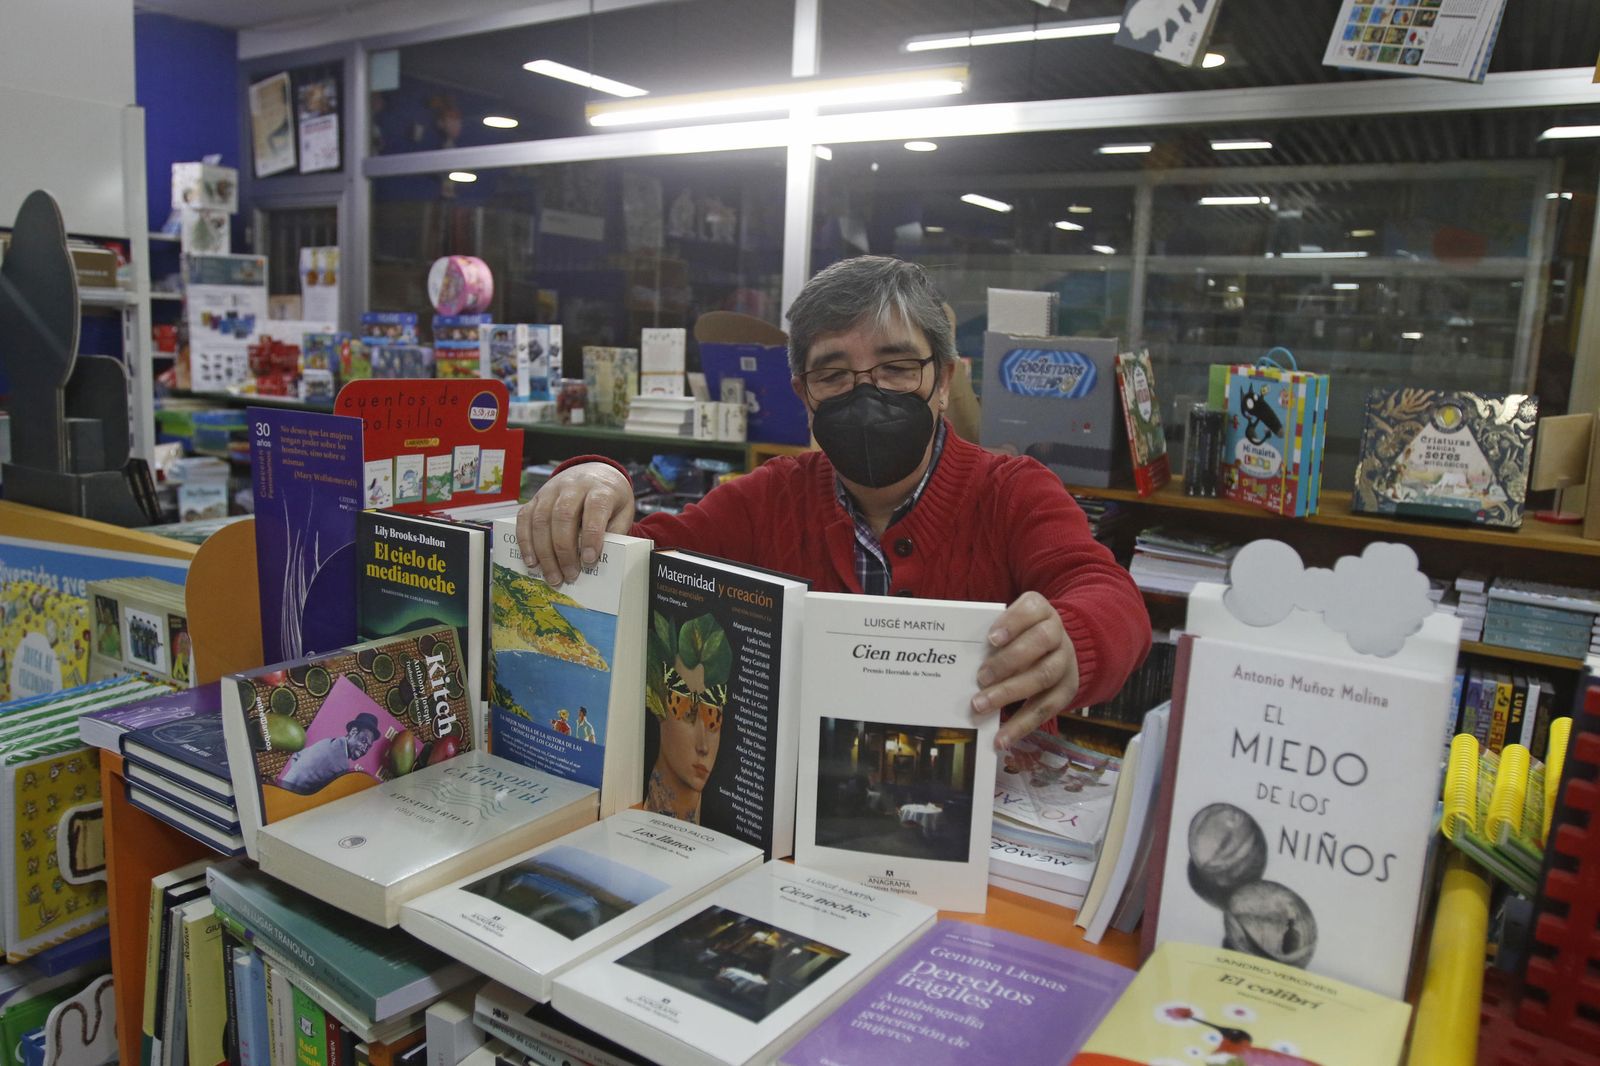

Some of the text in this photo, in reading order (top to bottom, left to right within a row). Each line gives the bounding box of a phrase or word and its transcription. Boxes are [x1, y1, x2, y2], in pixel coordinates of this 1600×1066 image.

[345, 385, 459, 408] cuentos de
[361, 408, 443, 431] bolsillo
[256, 422, 270, 437] 30
[291, 427, 307, 435] deseo
[309, 429, 319, 438] que
[321, 429, 329, 437] las
[330, 432, 353, 441] mujeres
[280, 437, 346, 450] tengan poder sobre los
[1421, 436, 1470, 447] Criaturas
[324, 451, 339, 460] sobre
[1243, 444, 1276, 459] Mi maleta
[1425, 451, 1461, 461] seres
[282, 459, 304, 467] mismas
[294, 471, 312, 480] (Mary
[375, 525, 445, 548] Lily Brooks-Dalton
[375, 542, 446, 573] El cielo de
[367, 564, 456, 595] medianoche
[658, 564, 773, 609] Maternidad y creación
[733, 622, 772, 638] Margaret Atwood
[864, 617, 945, 631] LUISGÉ MARTÍN
[747, 637, 771, 649] Lydia Davis
[740, 655, 752, 665] Mary
[742, 646, 770, 660] Annie Ernaux
[853, 644, 956, 665] Cien noches
[742, 666, 770, 680] Susan Griffin
[739, 675, 769, 690] Nancy Huston
[1234, 664, 1389, 708] Antonio Muñoz Molina
[413, 660, 432, 725] Anthony Joseph
[426, 652, 457, 737] Kitch
[753, 691, 768, 700] Lazarre
[732, 693, 746, 703] Ursula
[757, 703, 768, 711] Guin
[1511, 692, 1525, 724] LUNA
[735, 714, 767, 730] Margaret Mead
[740, 706, 767, 723] Doris Lessing
[1264, 704, 1285, 726] EL
[519, 722, 533, 732] NOVELA
[540, 730, 546, 738] LA
[546, 733, 565, 746] AUTORA
[573, 743, 582, 752] LAS
[536, 736, 545, 745] LOS
[737, 725, 767, 742] Toni Morrison
[736, 745, 747, 755] Alicia
[743, 737, 766, 751] Tillie Olsen
[741, 757, 765, 772] Grace Paley
[1232, 727, 1369, 787] MIEDO
[467, 764, 549, 794] ZENOBIA
[735, 775, 764, 791] Adrienne Rich
[741, 767, 764, 781] Sylvia Plath
[720, 787, 731, 797] Susan
[732, 792, 744, 802] Rubin
[737, 785, 763, 801] Sara Ruddick
[1257, 782, 1330, 815] DE LOS
[390, 793, 462, 824] EPISTOLARIO
[732, 803, 763, 821] Mona Simpson
[650, 818, 715, 842] FEDERICO FALCO
[736, 815, 762, 830] Alice Walker
[633, 828, 696, 852] Los llanos
[744, 828, 761, 840] Williams
[1279, 825, 1397, 882] NIÑOS
[806, 878, 875, 902] LUISGÉ MARTÍN
[868, 877, 911, 888] ANAGRAMA
[780, 885, 871, 918] Cien noches
[250, 909, 315, 967] LUGAR TRANQUILO
[931, 946, 1068, 993] Gemma Lienas
[1216, 957, 1337, 996] SANDRO VERONESI
[897, 973, 994, 1010] frágiles
[911, 959, 1035, 1006] Derechos
[1219, 973, 1323, 1009] El colibrí
[871, 1000, 924, 1022] de una
[880, 992, 985, 1031] Autobiografía
[516, 1033, 524, 1043] de
[851, 1019, 914, 1044] mujeres
[858, 1010, 970, 1049] generación de
